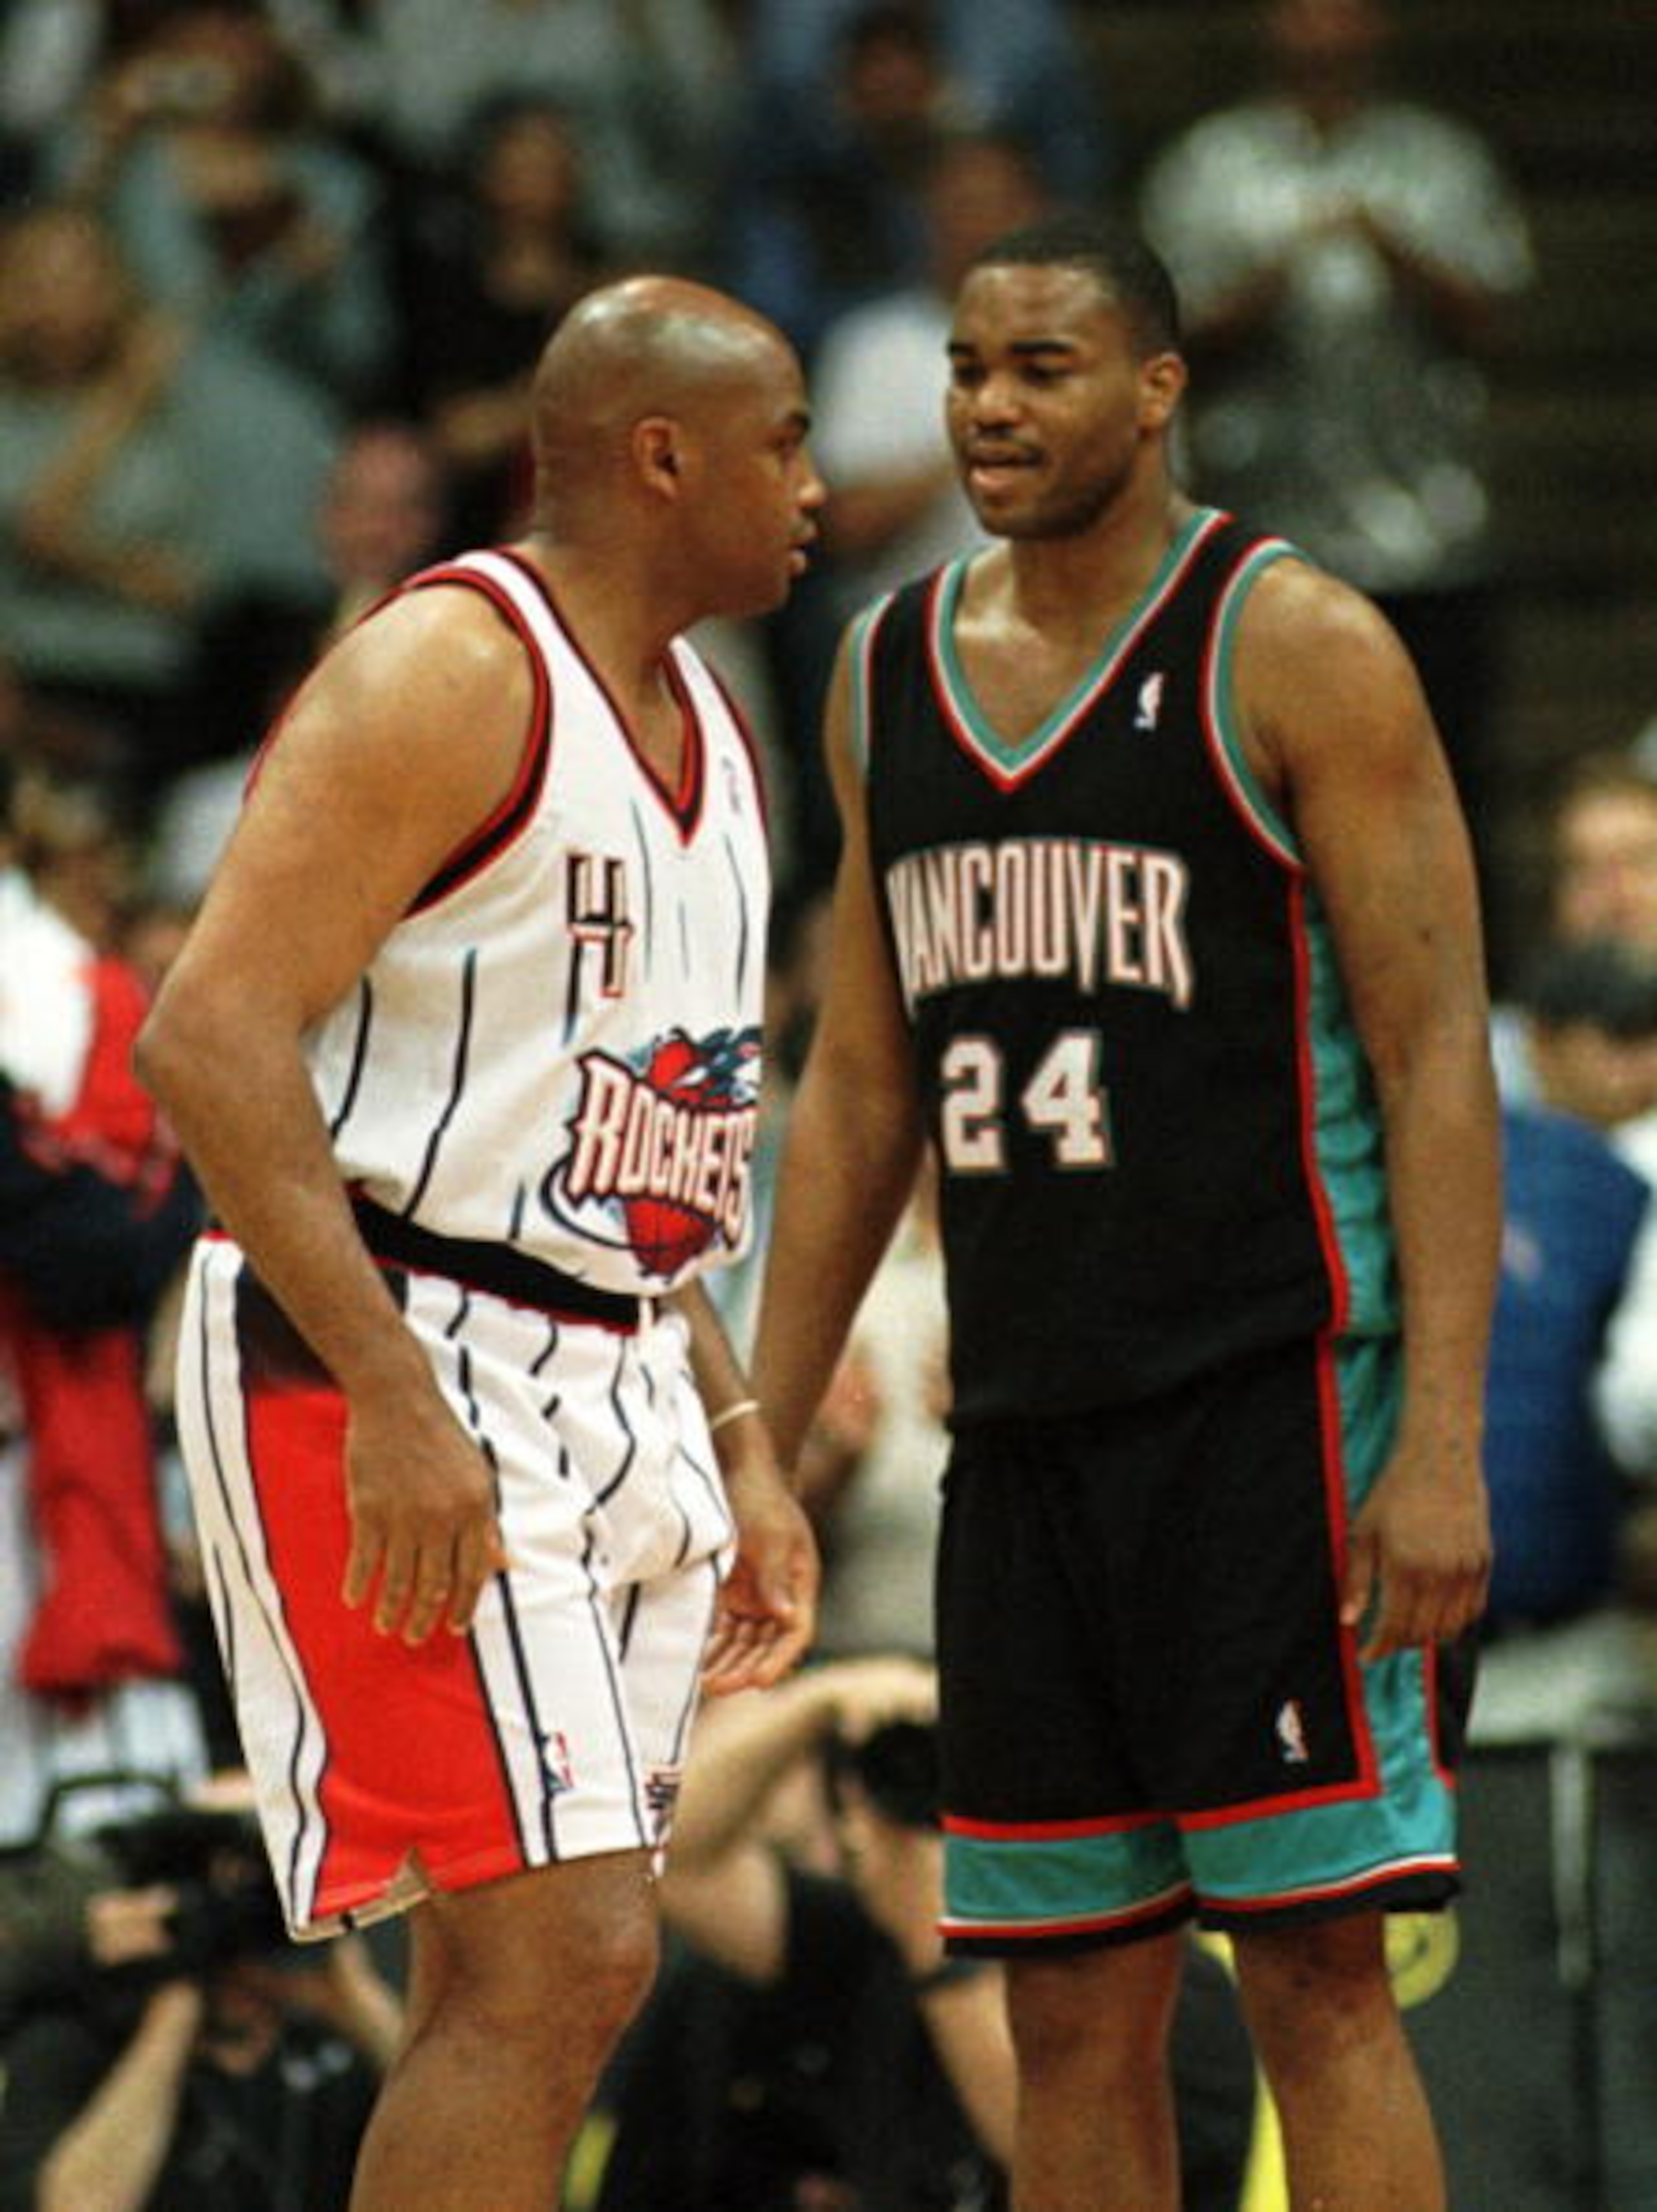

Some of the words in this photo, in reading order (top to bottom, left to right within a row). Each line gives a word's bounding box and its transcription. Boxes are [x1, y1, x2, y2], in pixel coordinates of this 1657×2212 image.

[885, 838, 1192, 1018] VANCOUVER
[564, 1053, 757, 1247] ROCKETS
[940, 1031, 1111, 1169] 24
